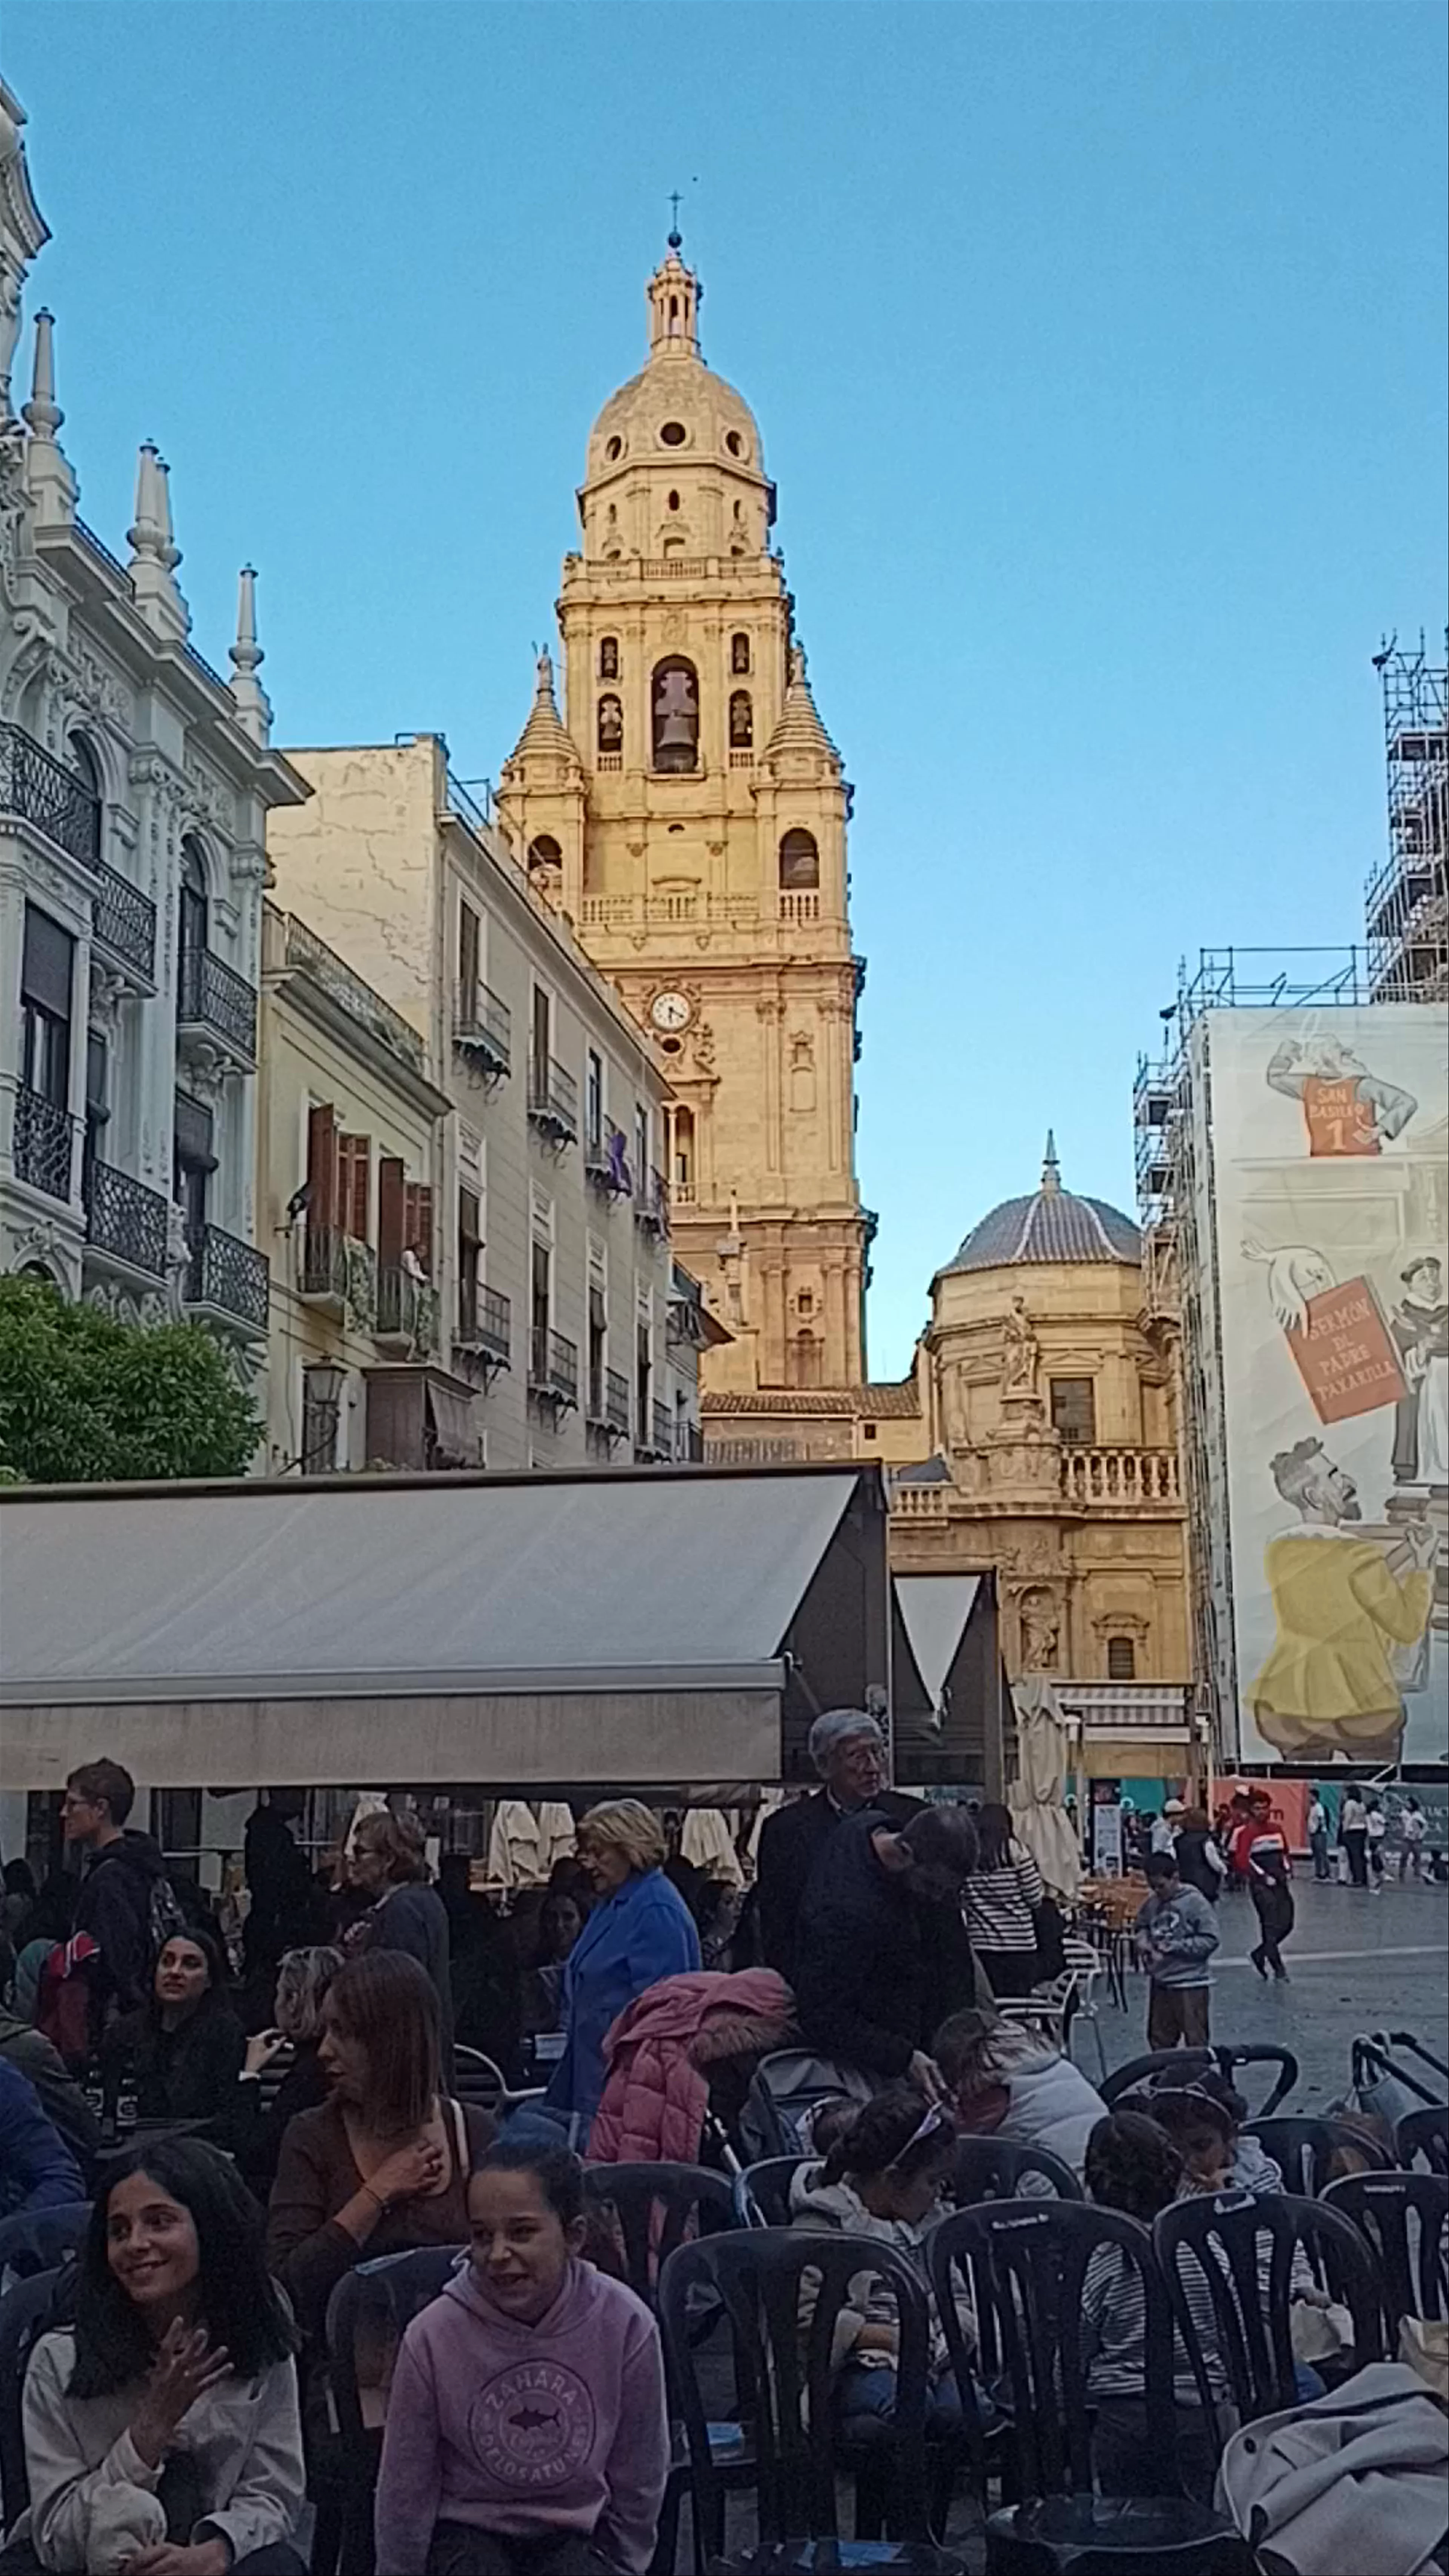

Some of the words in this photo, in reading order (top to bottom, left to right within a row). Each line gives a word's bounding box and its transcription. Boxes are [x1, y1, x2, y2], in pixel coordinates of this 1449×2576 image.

[1317, 1088, 1347, 1104] SAN
[1325, 1120, 1346, 1150] 1
[1319, 1344, 1371, 1376] PADRE
[486, 2370, 578, 2410] ZAHARA
